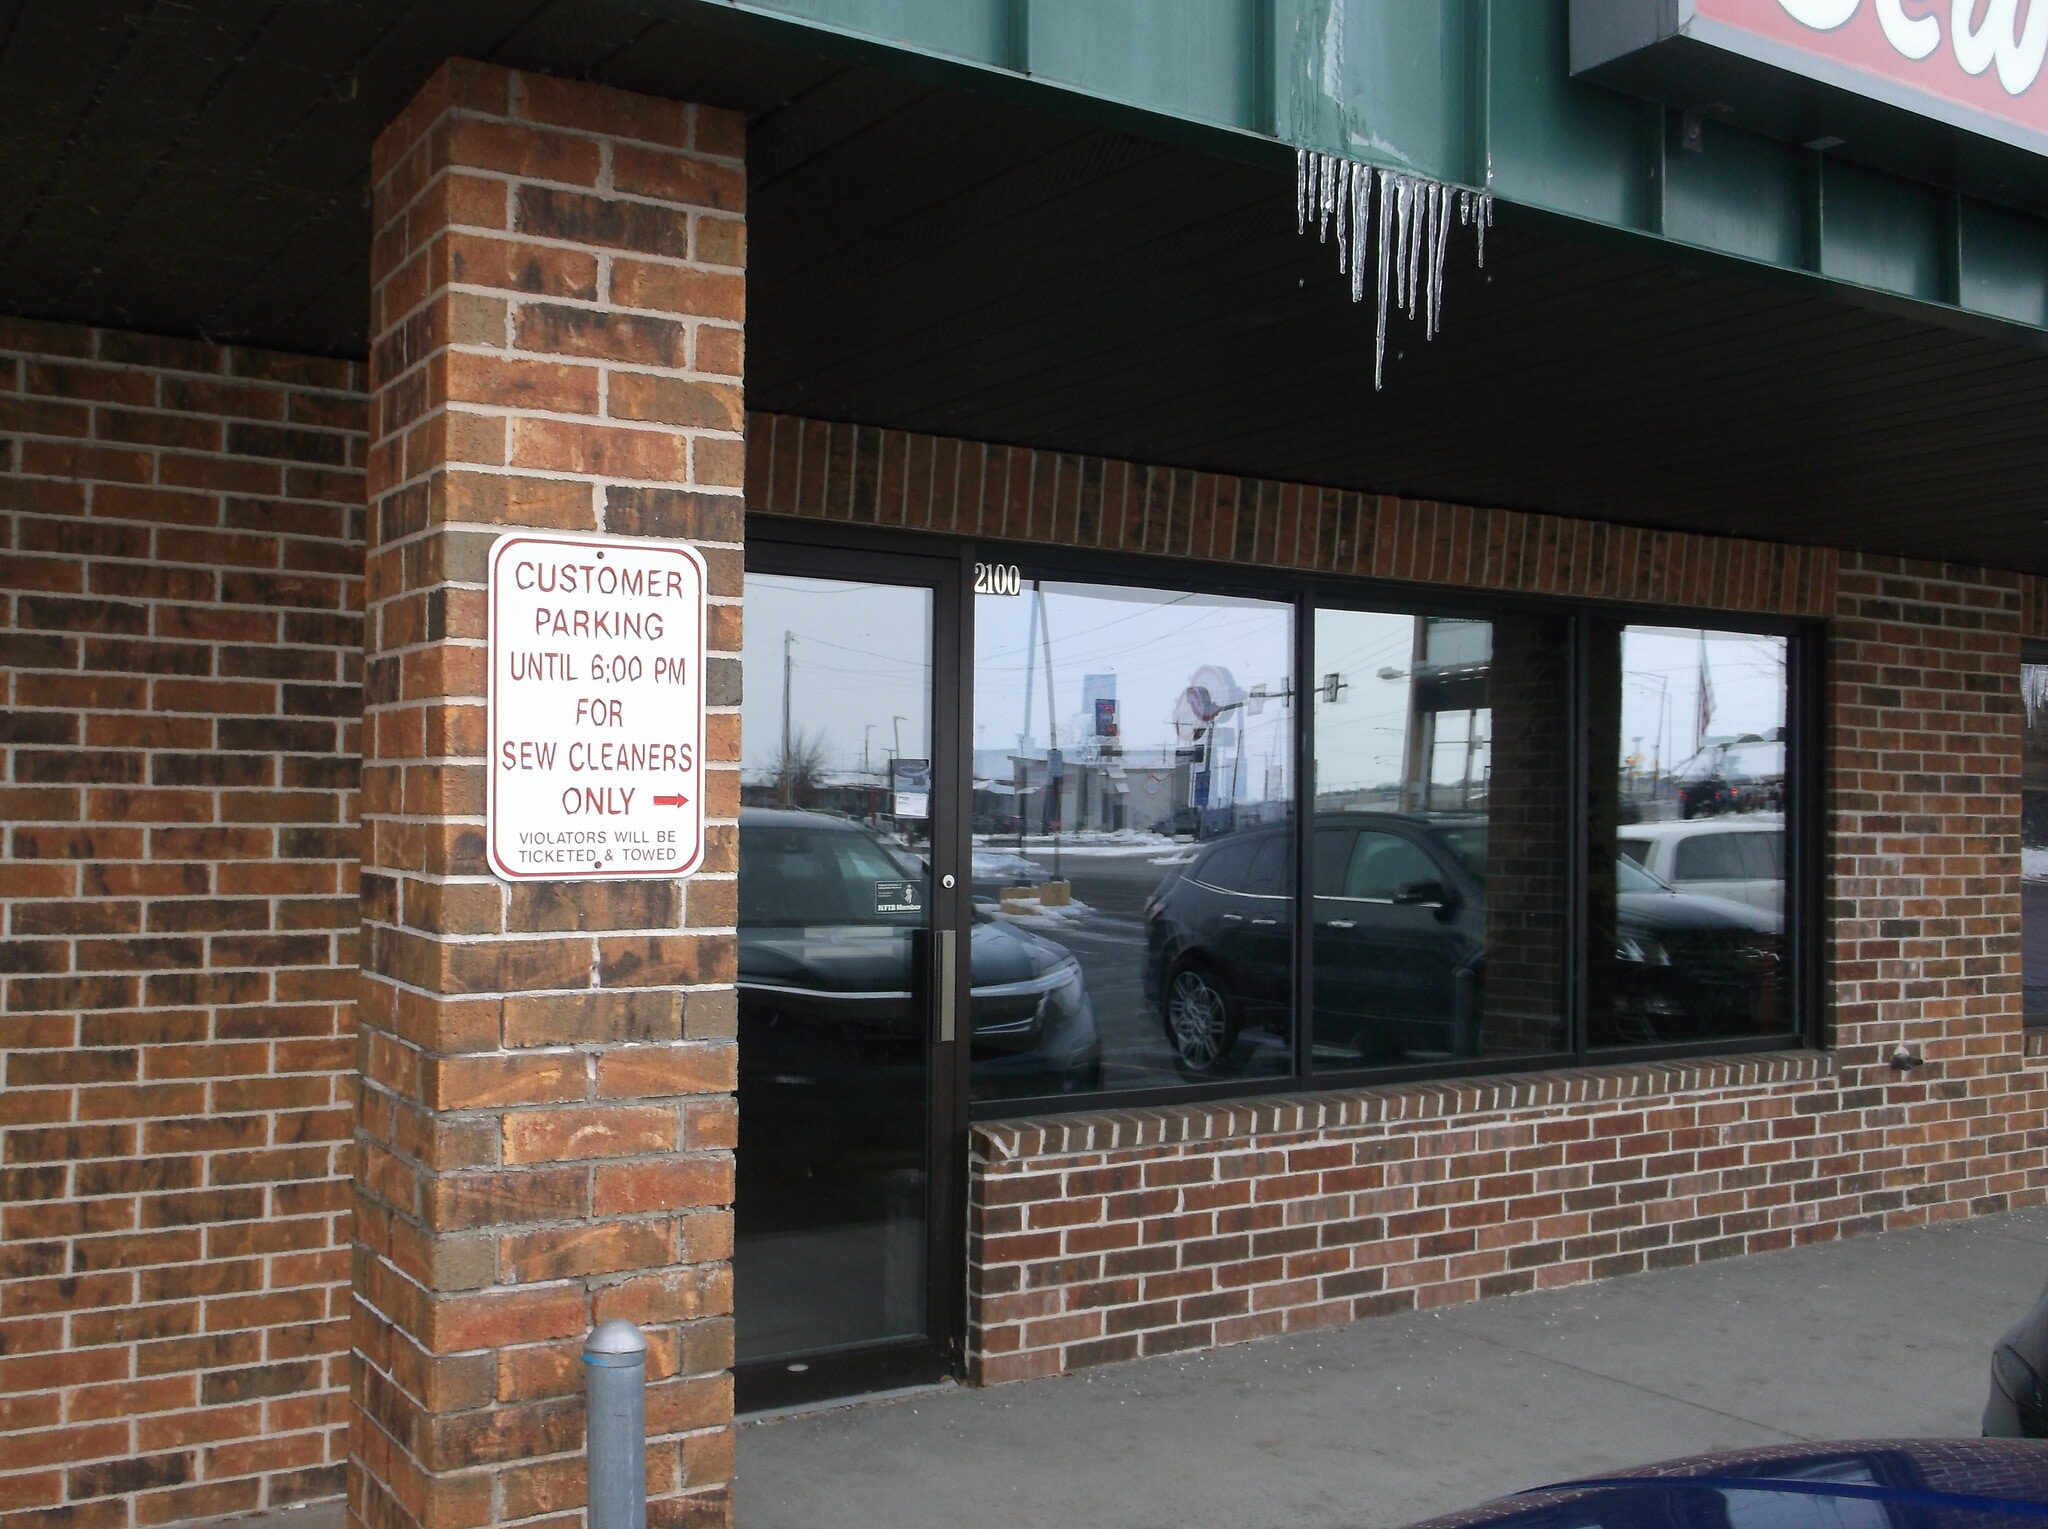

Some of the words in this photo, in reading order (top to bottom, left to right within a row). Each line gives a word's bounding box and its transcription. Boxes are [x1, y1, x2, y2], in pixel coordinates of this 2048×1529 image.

[516, 562, 682, 599] CUSTOMER
[974, 562, 1021, 596] 2100
[536, 608, 663, 641] PARKING
[511, 652, 578, 681] UNTIL
[592, 654, 642, 683] 6:00
[655, 657, 685, 685] PM
[576, 698, 622, 727] FOR
[502, 741, 557, 771] SEW
[569, 742, 692, 772] CLEANERS
[562, 787, 635, 815] ONLY
[520, 831, 606, 844] VIOLATORS
[615, 832, 649, 843] WILL
[658, 831, 675, 842] BE
[519, 850, 597, 862] TICKETED
[605, 849, 613, 861] &
[622, 848, 676, 860] TOWED
